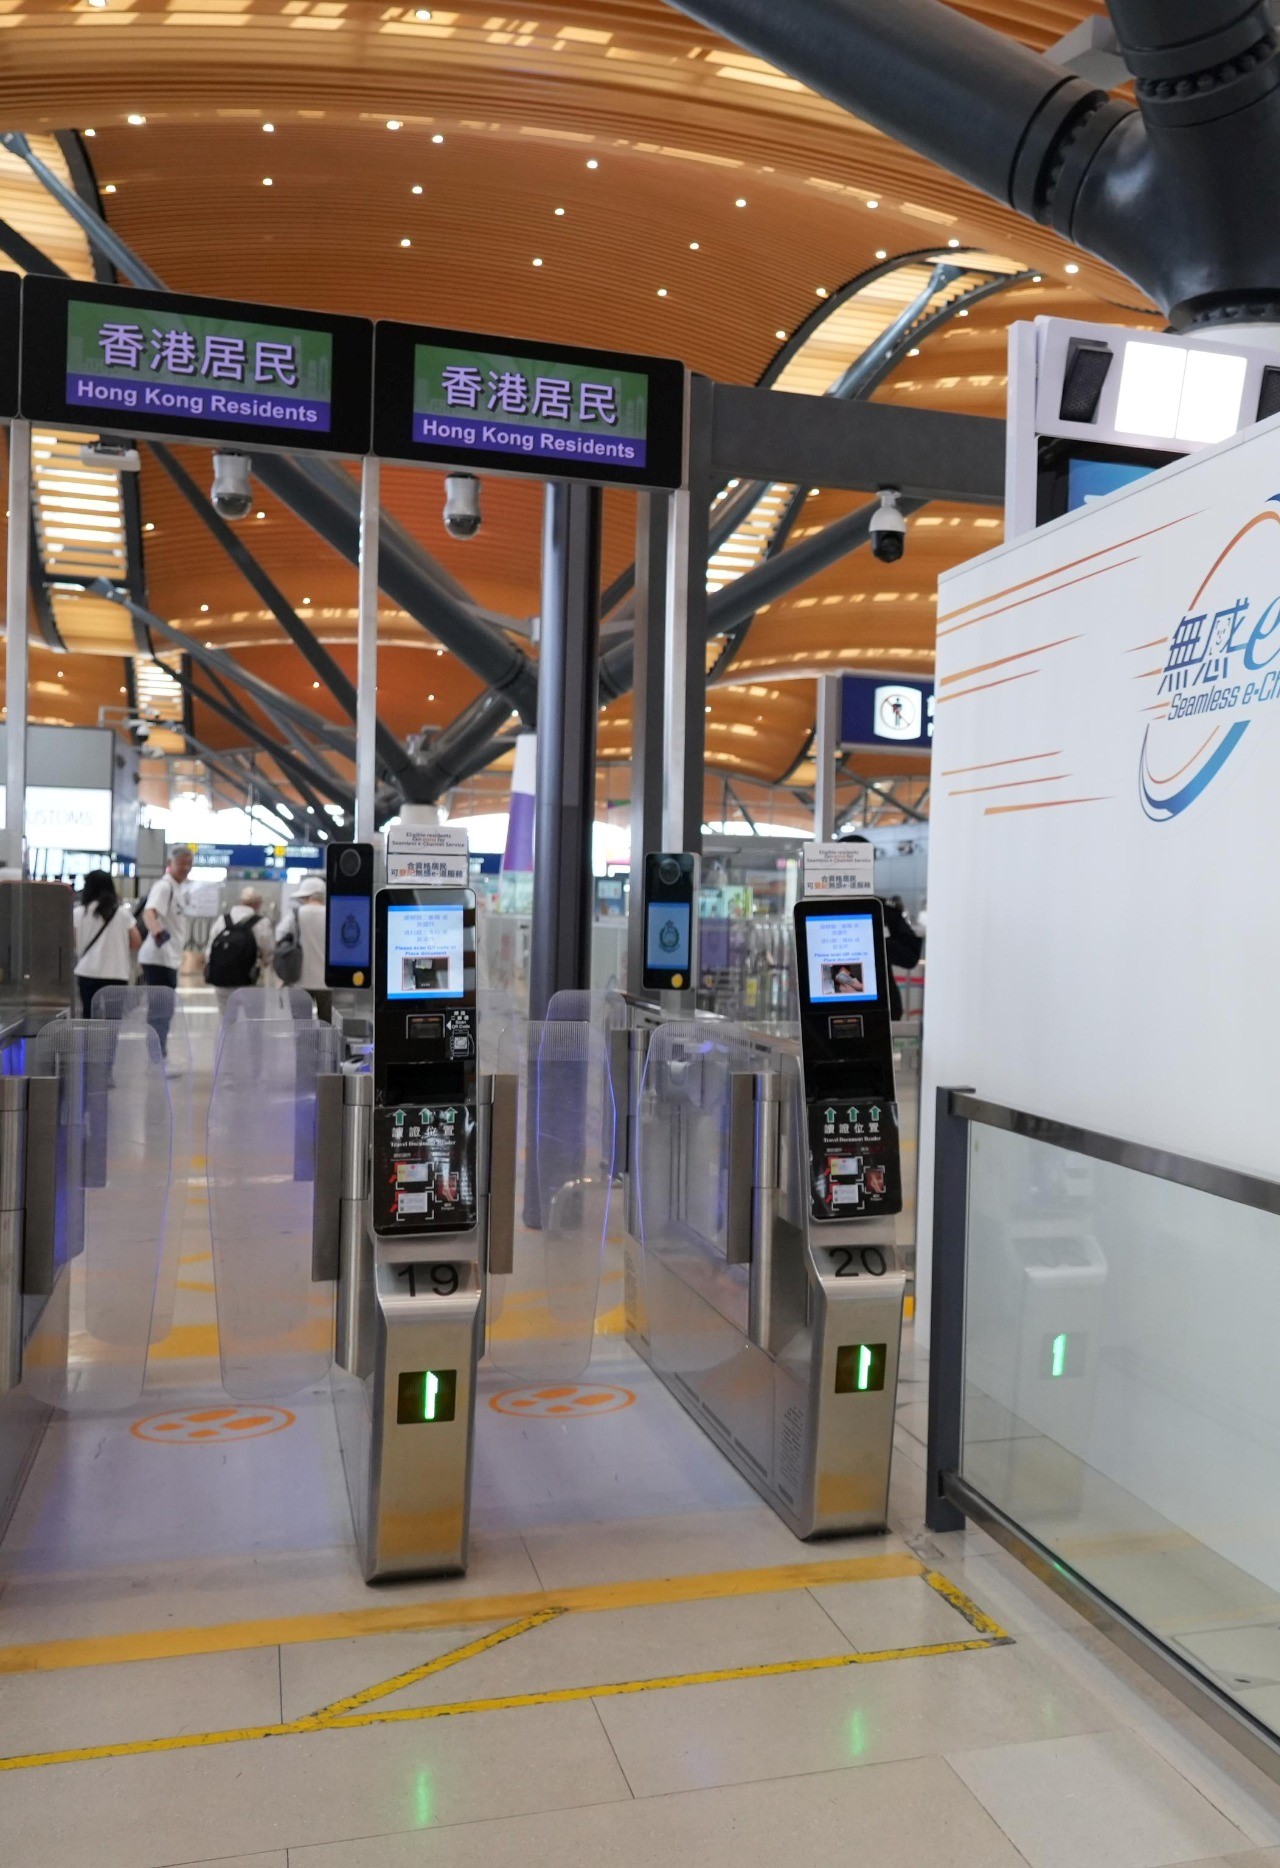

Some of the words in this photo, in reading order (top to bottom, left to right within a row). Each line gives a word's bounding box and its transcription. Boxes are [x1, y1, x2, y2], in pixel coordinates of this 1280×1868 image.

[98, 323, 298, 386] 香港居民
[77, 379, 138, 405] Hong
[145, 388, 203, 414] Kong
[211, 395, 318, 423] Residents
[441, 366, 617, 424] 香港居民
[423, 419, 476, 444] Hong
[482, 426, 534, 451] Kong
[541, 433, 635, 459] Residents
[1168, 685, 1241, 721] Seamless
[26, 808, 94, 826] USTOMS
[398, 1263, 459, 1297] 19
[829, 1247, 887, 1278] 20
